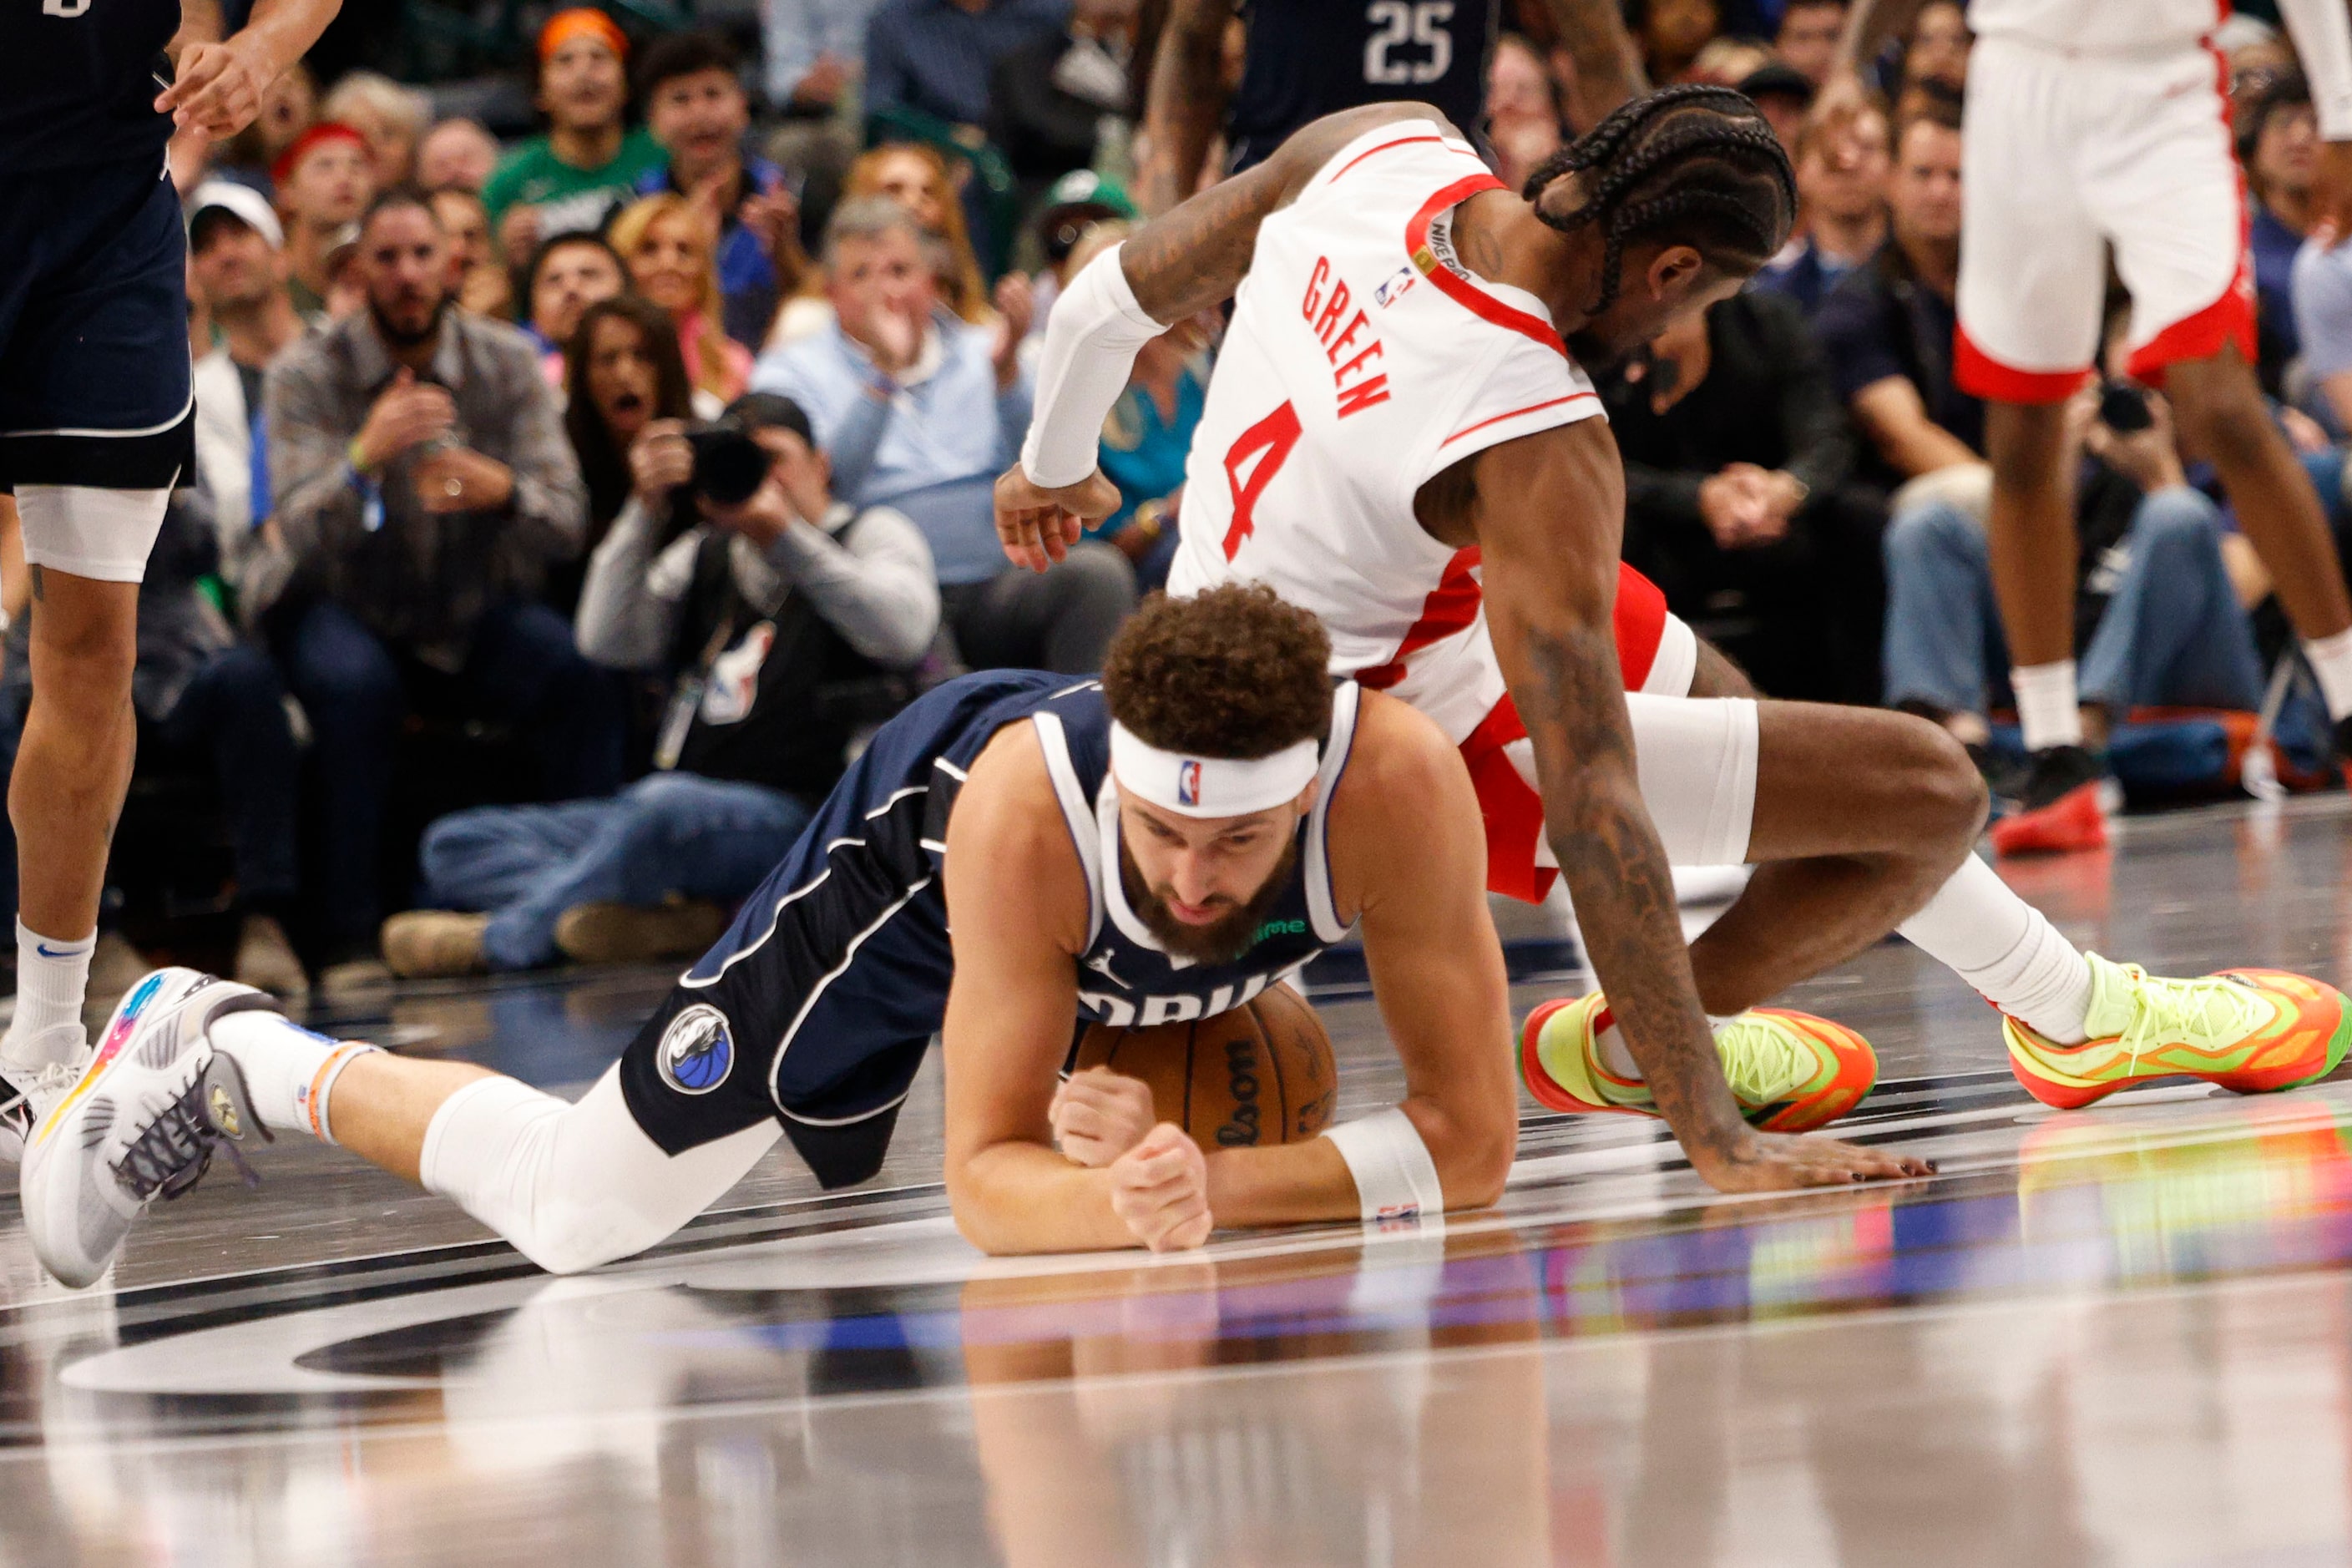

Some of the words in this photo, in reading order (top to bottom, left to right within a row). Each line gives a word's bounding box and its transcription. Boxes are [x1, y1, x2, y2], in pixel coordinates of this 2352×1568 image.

[1363, 1, 1455, 84] 25
[1431, 222, 1451, 257] NIKE
[1302, 255, 1391, 420] GREEN
[1222, 398, 1304, 565] 4
[1216, 1039, 1261, 1146] lson
